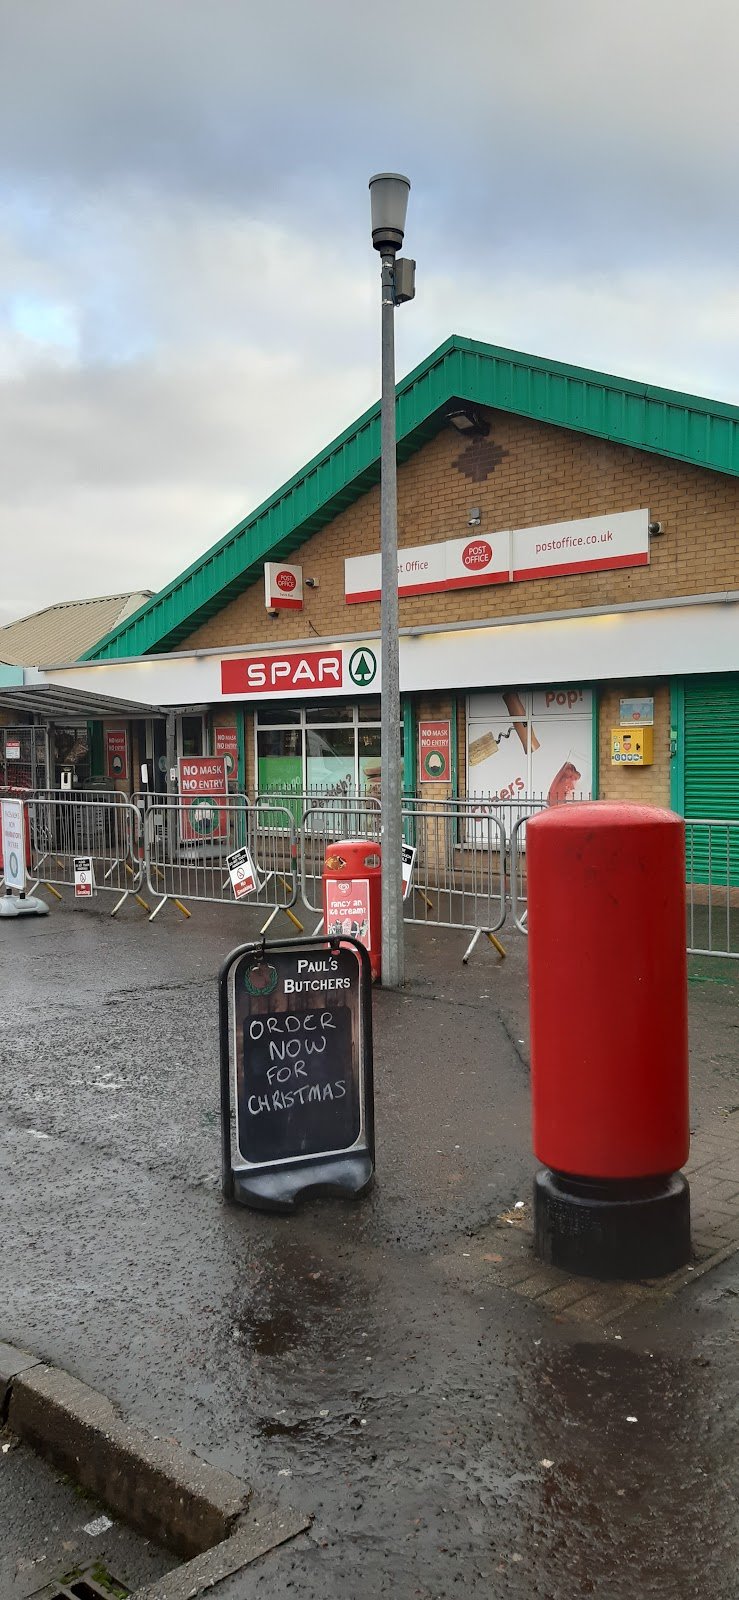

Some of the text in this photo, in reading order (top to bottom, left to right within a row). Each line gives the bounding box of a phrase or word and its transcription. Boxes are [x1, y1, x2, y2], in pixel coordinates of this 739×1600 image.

[468, 545, 487, 556] POST
[535, 531, 613, 553] postoffice.co.uk
[405, 560, 429, 572] Office
[464, 553, 489, 564] OFFICE
[247, 657, 340, 687] SPAR
[183, 765, 222, 776] NO MASK
[182, 779, 224, 790] NO ENTRY
[284, 977, 351, 994] BUTCHERS
[249, 1012, 337, 1040] ORDER
[269, 1035, 327, 1061] NOW
[266, 1060, 308, 1086] FOR
[247, 1080, 346, 1115] CHRISTMAS
